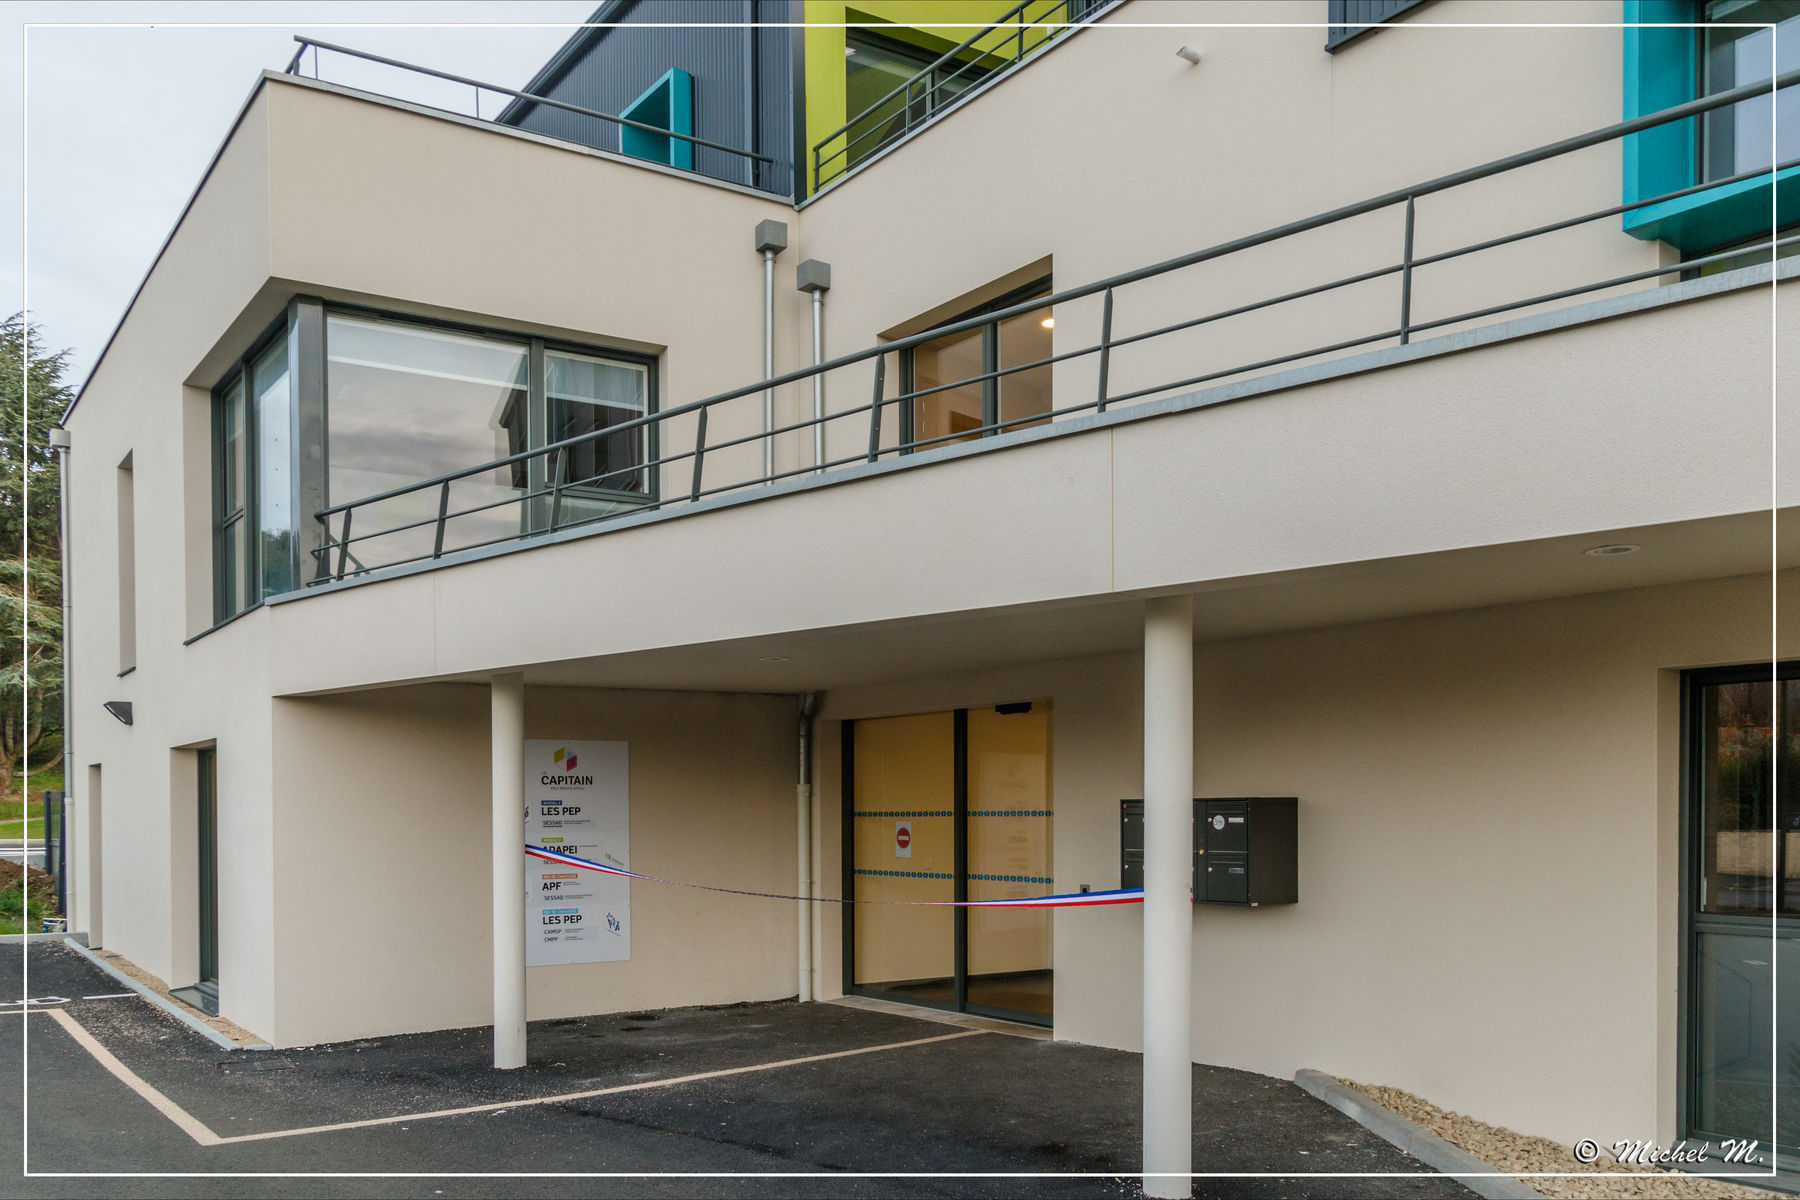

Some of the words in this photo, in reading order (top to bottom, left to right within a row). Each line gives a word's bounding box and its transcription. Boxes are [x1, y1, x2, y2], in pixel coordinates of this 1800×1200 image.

[541, 775, 593, 785] CAPITAIN
[541, 807, 560, 816] LES
[562, 807, 581, 816] PEP
[542, 881, 562, 891] APF
[542, 916, 561, 925] LES
[563, 914, 582, 924] PEP
